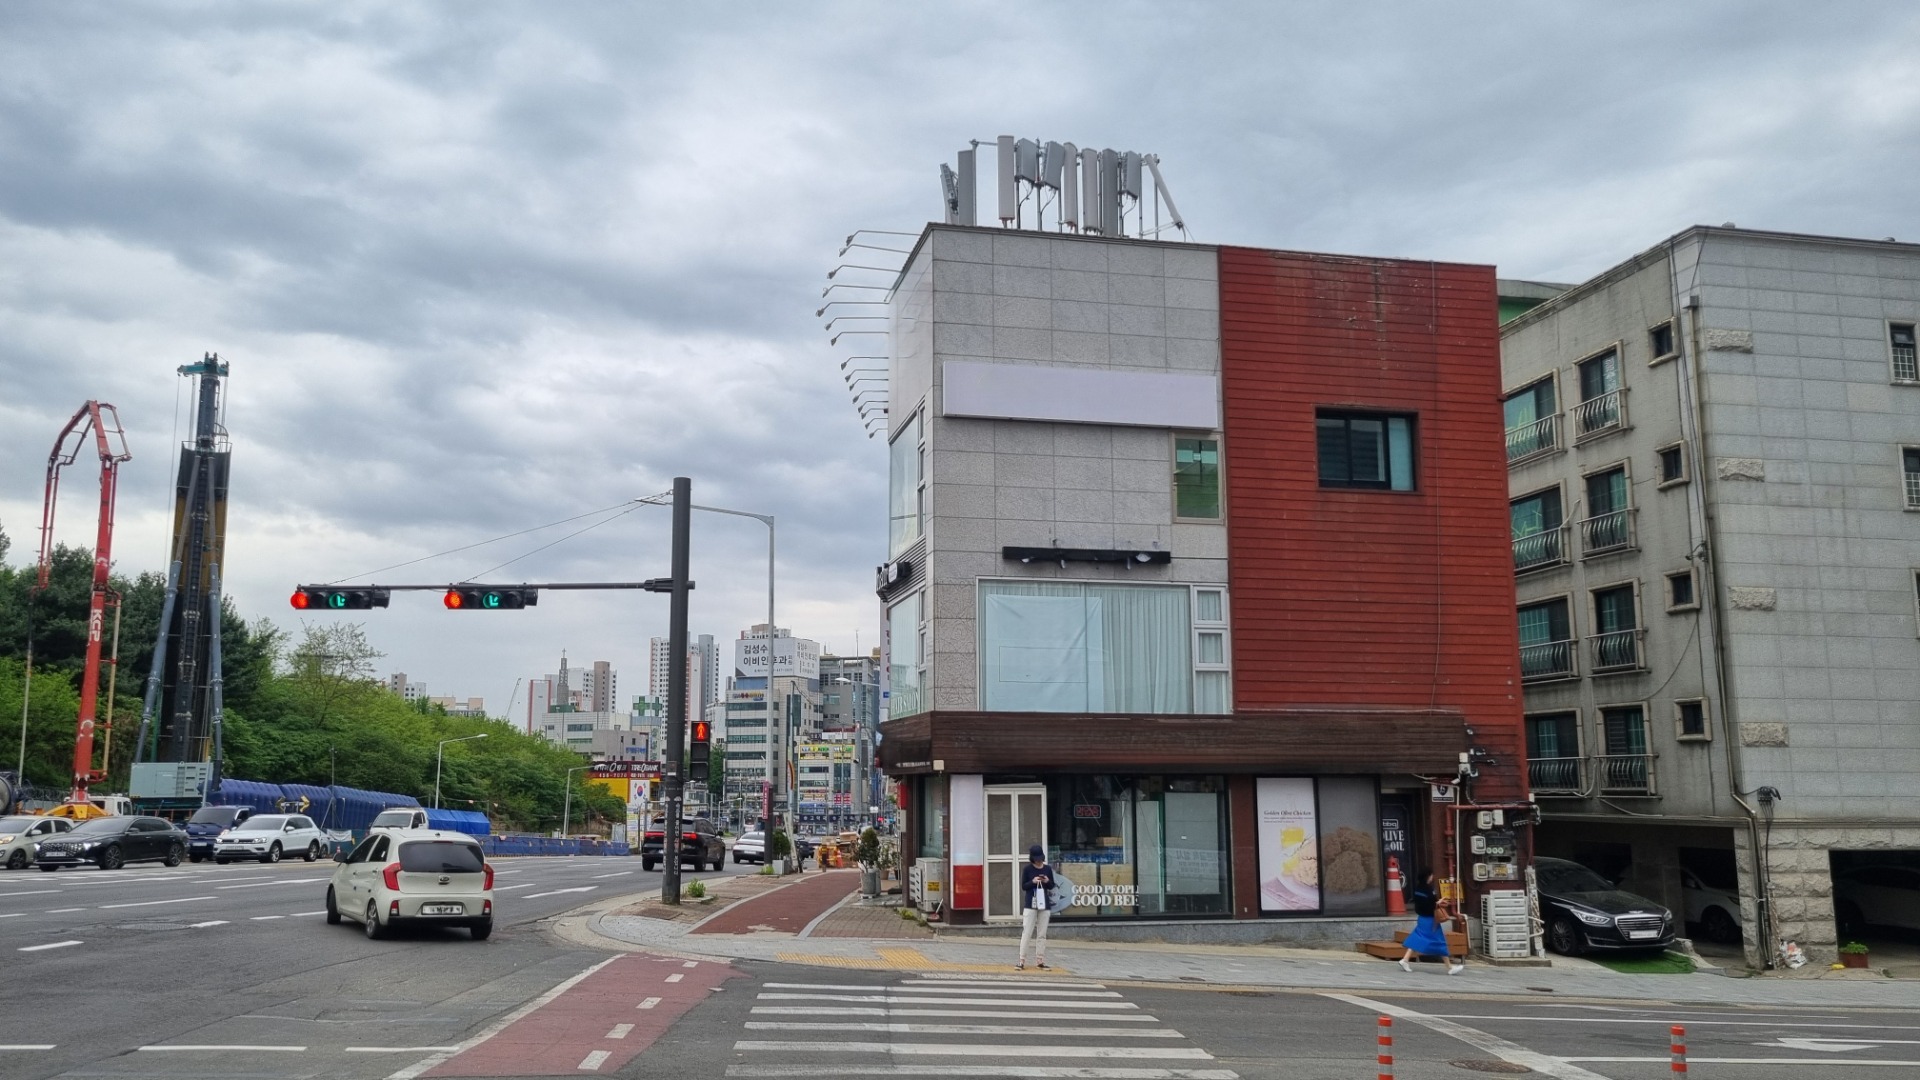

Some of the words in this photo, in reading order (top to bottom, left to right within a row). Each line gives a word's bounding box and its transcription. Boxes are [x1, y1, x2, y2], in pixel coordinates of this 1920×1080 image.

[90, 608, 102, 642] KCP
[743, 644, 768, 655] 김성수
[1390, 841, 1405, 852] OIL
[1071, 884, 1103, 894] GOOD
[1070, 894, 1112, 907] GOOD
